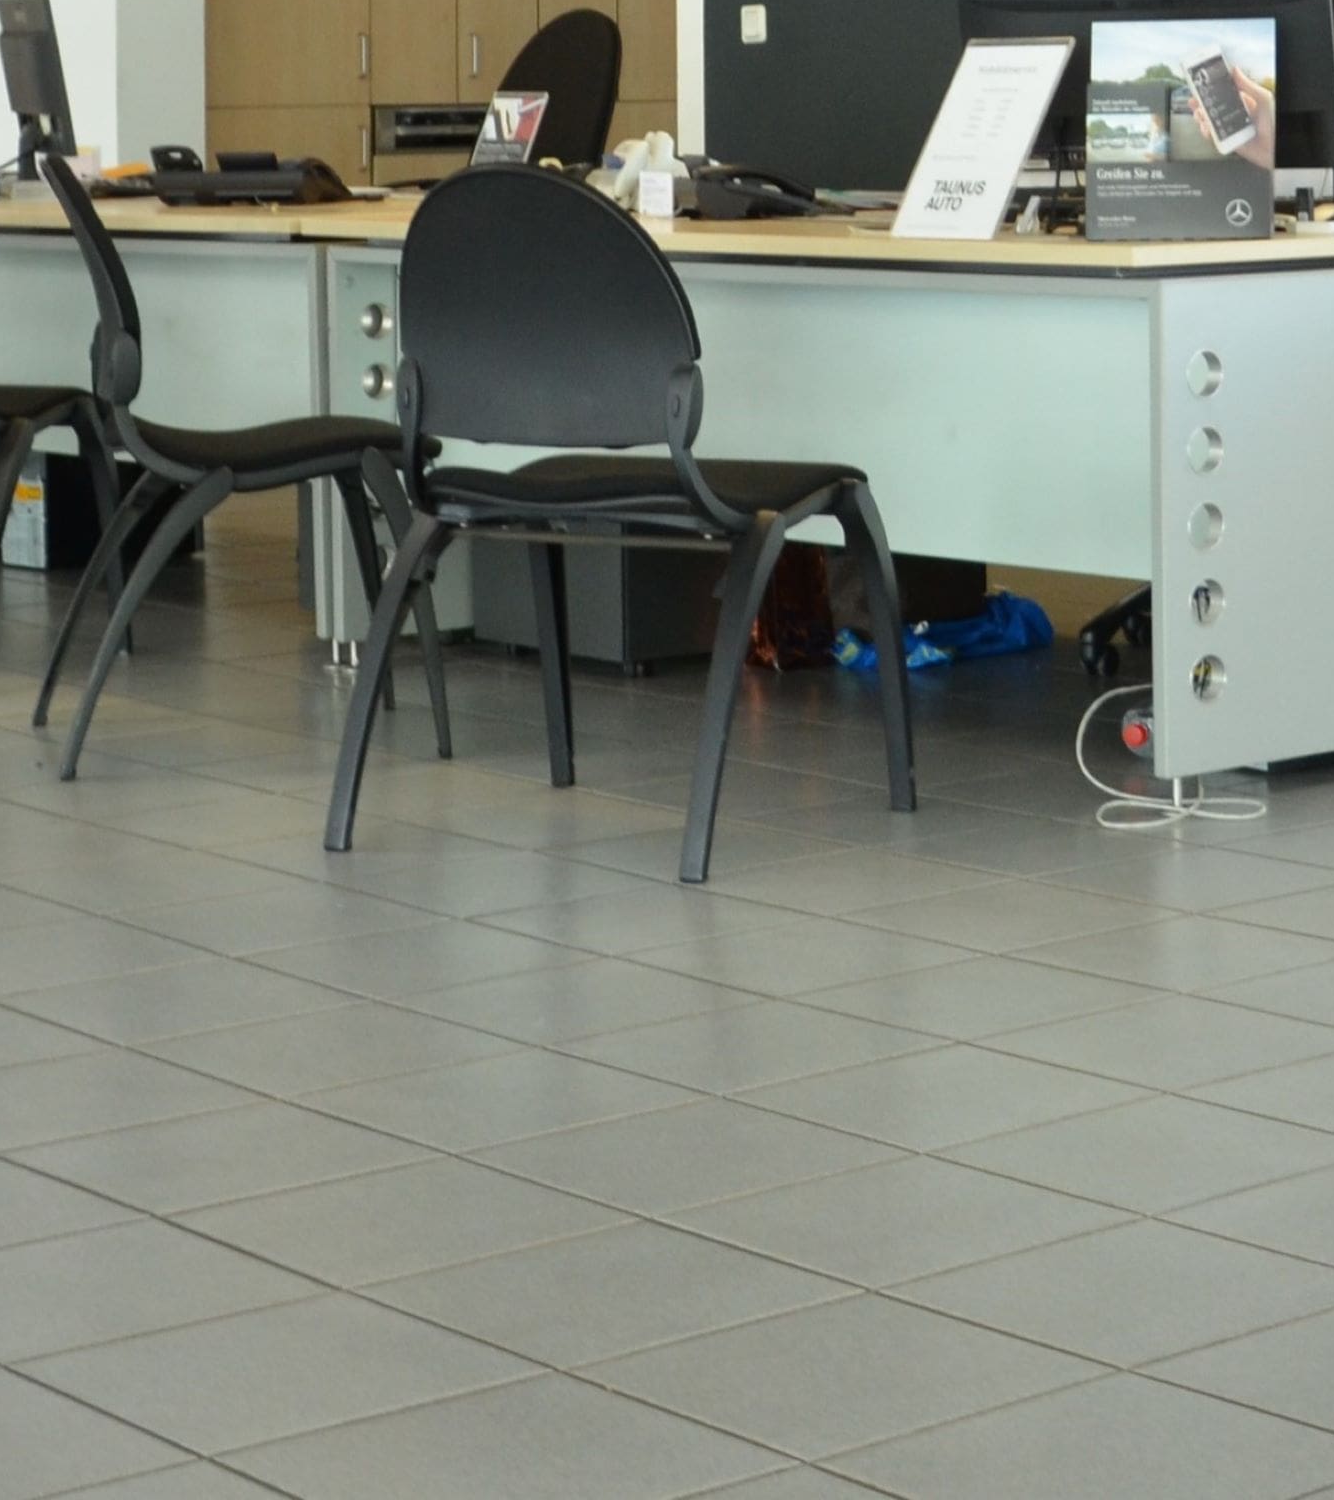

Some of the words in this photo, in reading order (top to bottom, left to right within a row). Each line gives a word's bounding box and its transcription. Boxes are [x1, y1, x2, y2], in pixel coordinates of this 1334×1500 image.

[1096, 167, 1132, 180] Greifen
[1134, 168, 1149, 180] Sie
[933, 180, 986, 195] TAUNUS
[924, 196, 963, 211] AUTO
